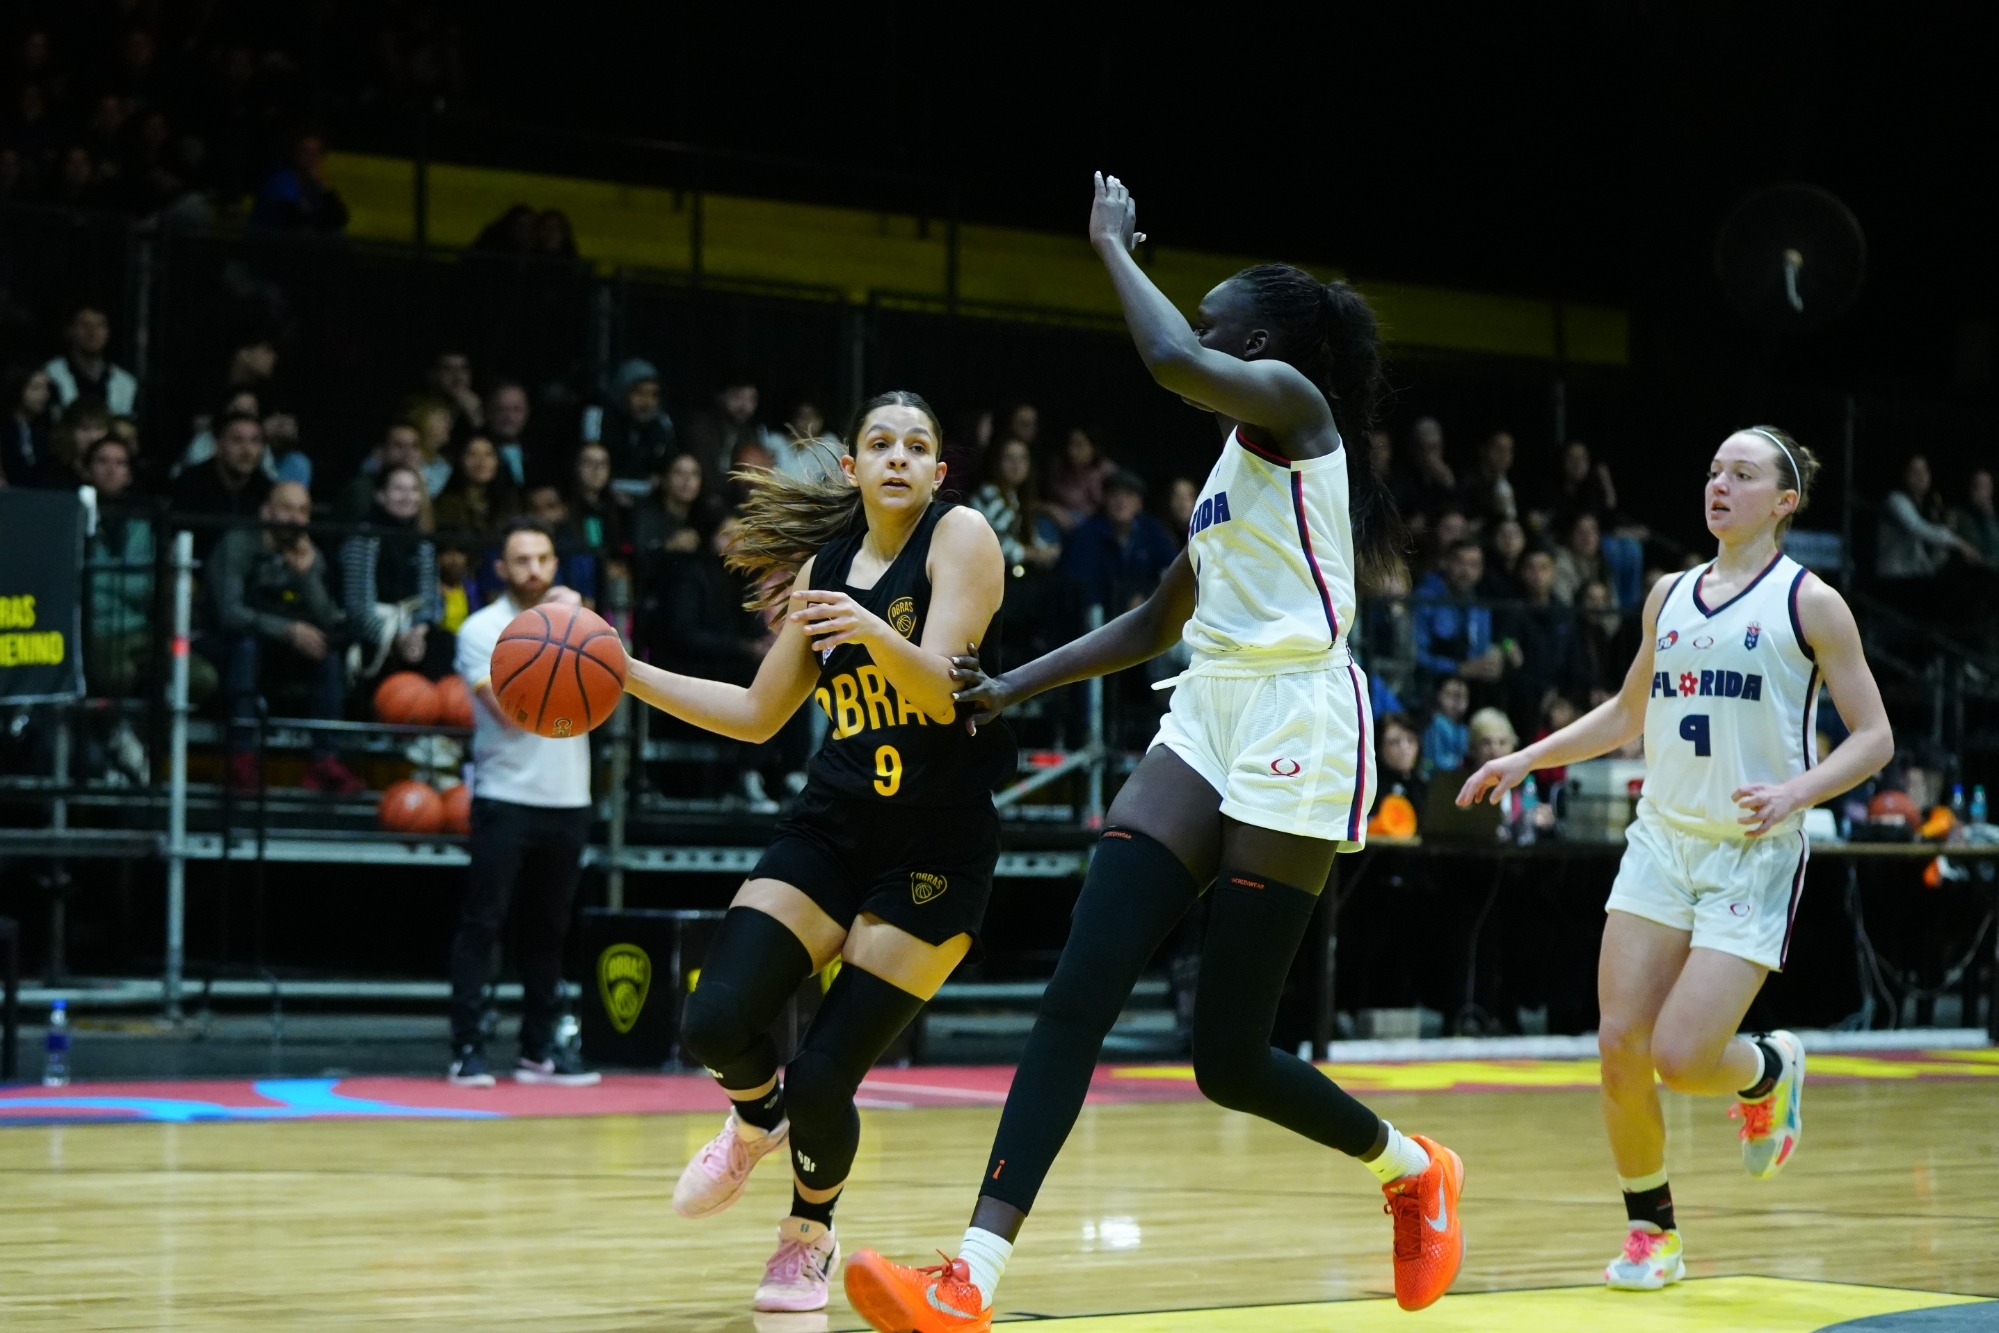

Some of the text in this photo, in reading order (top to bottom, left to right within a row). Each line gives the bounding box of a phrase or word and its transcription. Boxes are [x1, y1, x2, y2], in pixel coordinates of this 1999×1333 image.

[892, 601, 914, 617] OBRAS
[815, 665, 956, 740] OBRA
[1679, 714, 1711, 757] 9
[873, 744, 903, 797] 9
[915, 872, 943, 890] OBRAS
